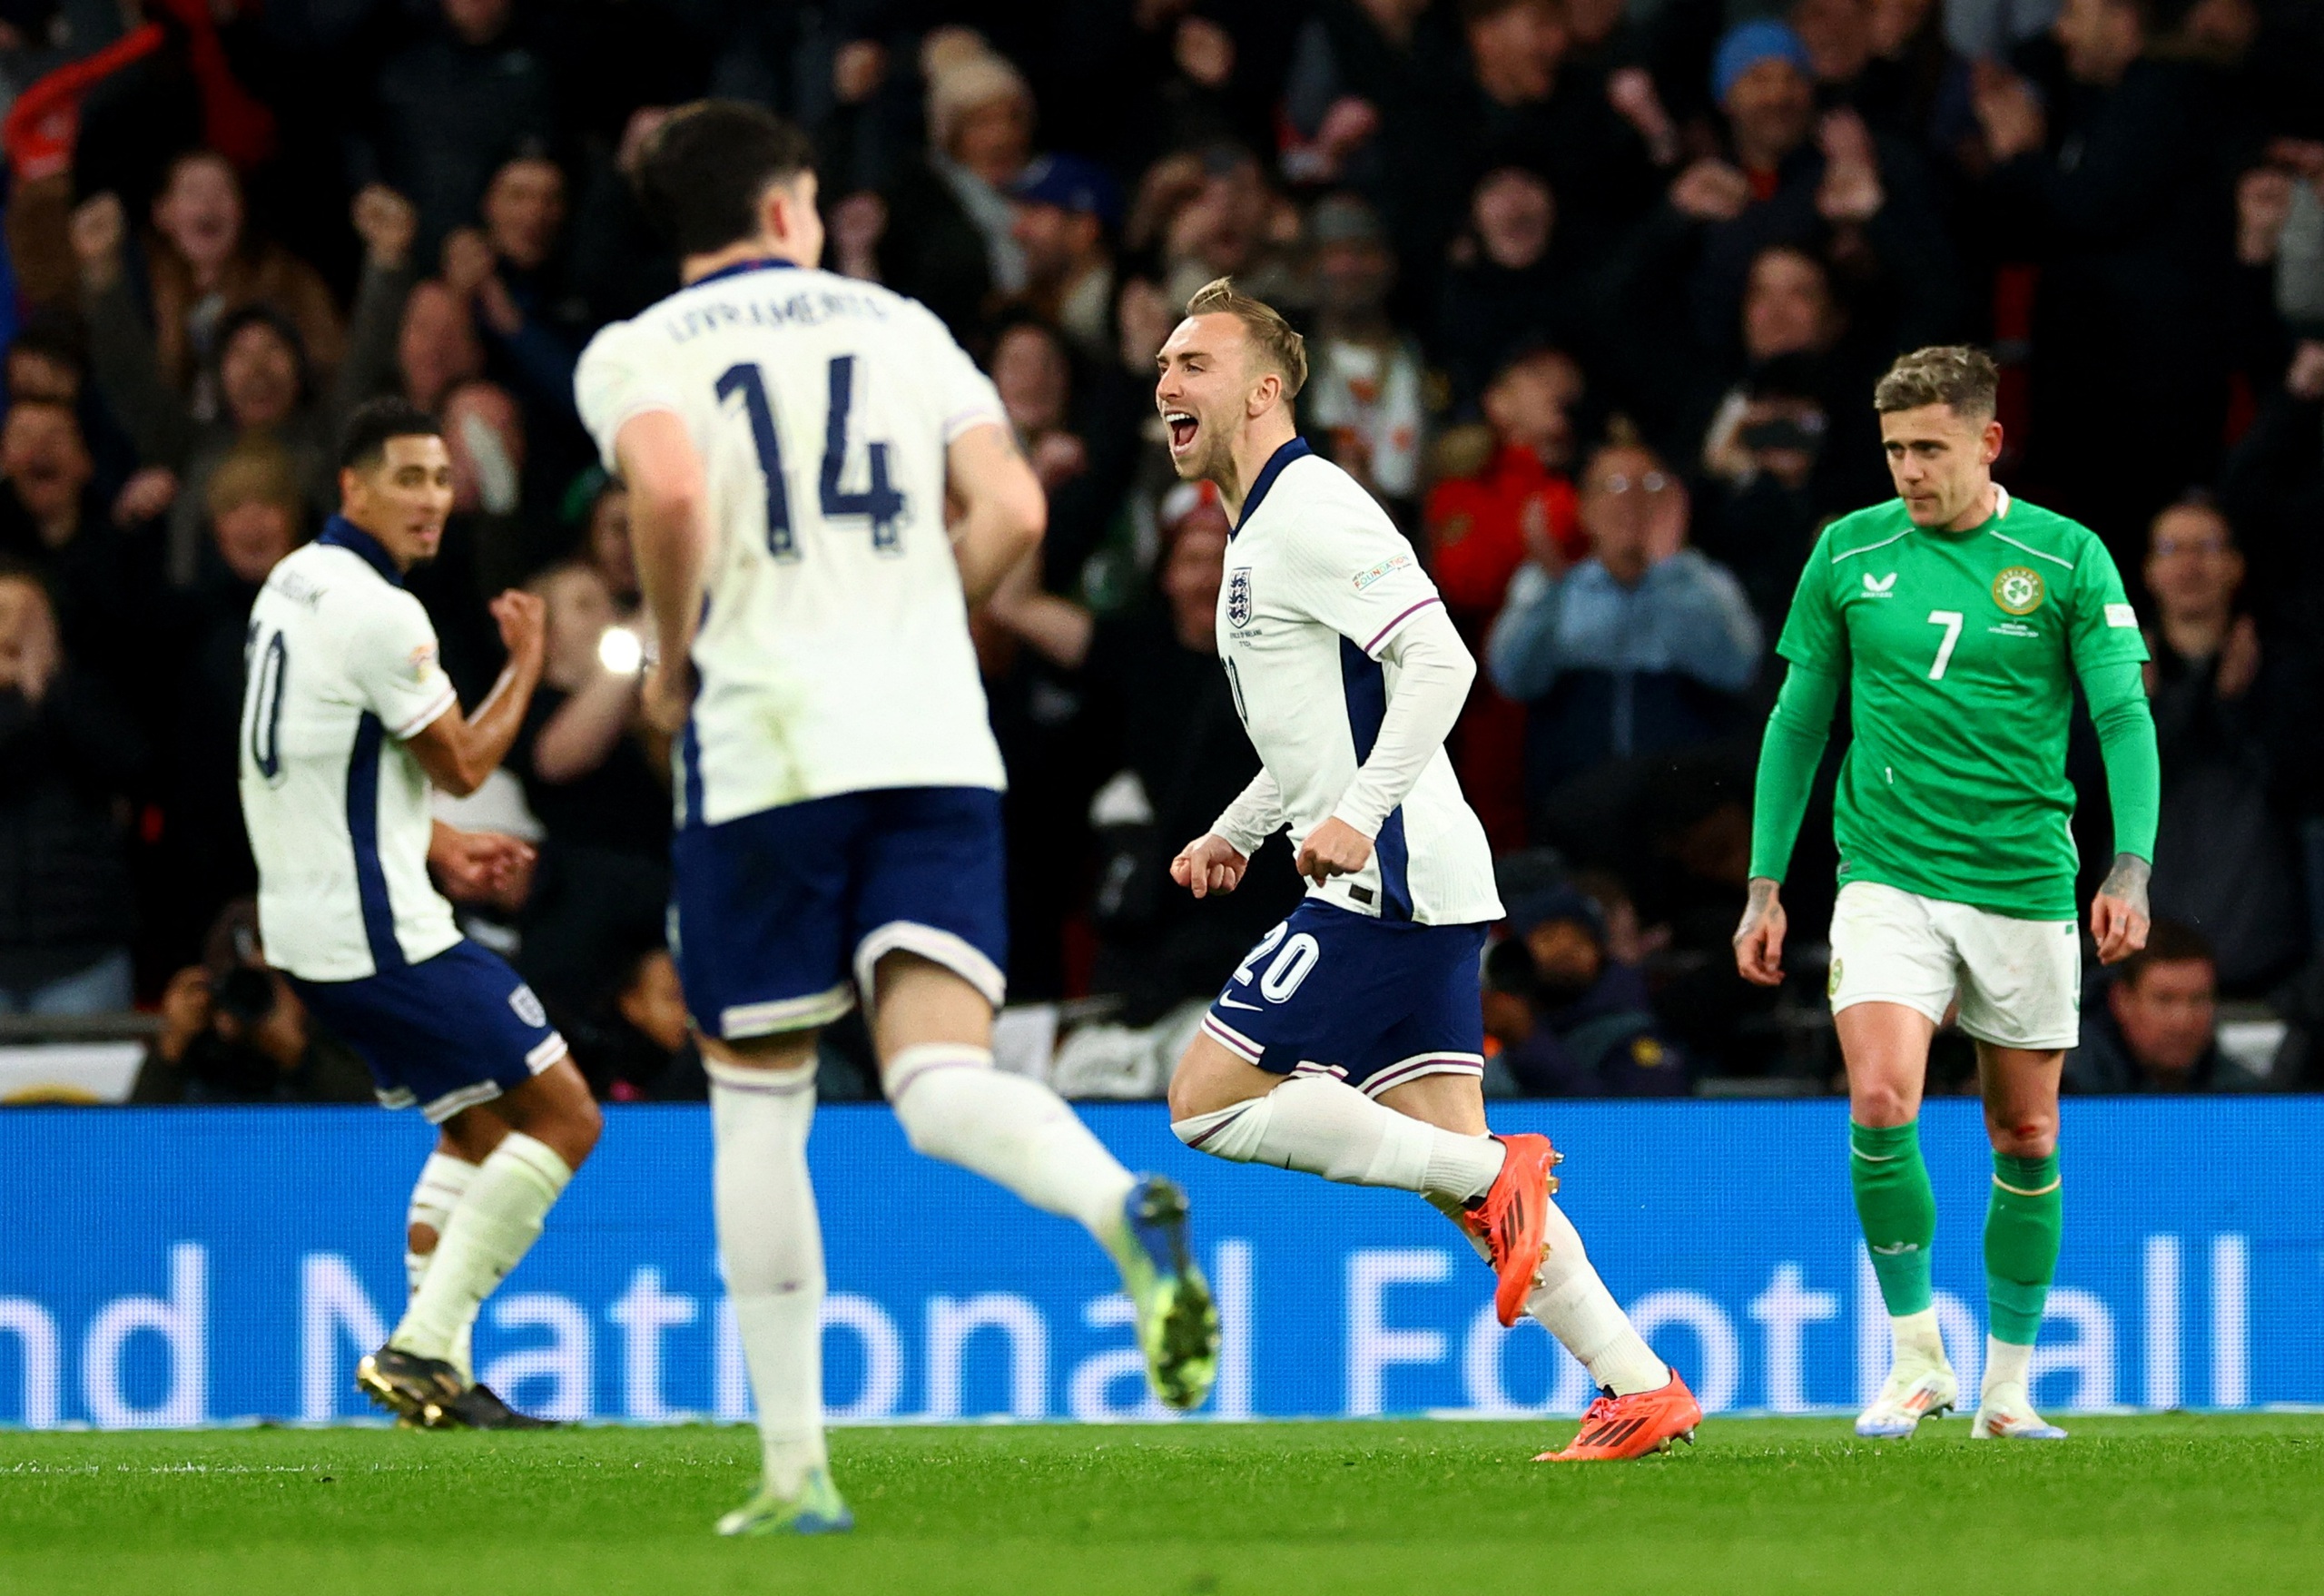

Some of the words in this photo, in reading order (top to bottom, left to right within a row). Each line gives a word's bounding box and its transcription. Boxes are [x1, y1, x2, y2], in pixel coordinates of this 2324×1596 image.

[714, 355, 910, 557] 14
[1926, 609, 1964, 681] 7
[1221, 655, 1249, 727] 0
[1232, 920, 1320, 1004] 20
[301, 1238, 1256, 1423] National
[1345, 1235, 2250, 1416] Football
